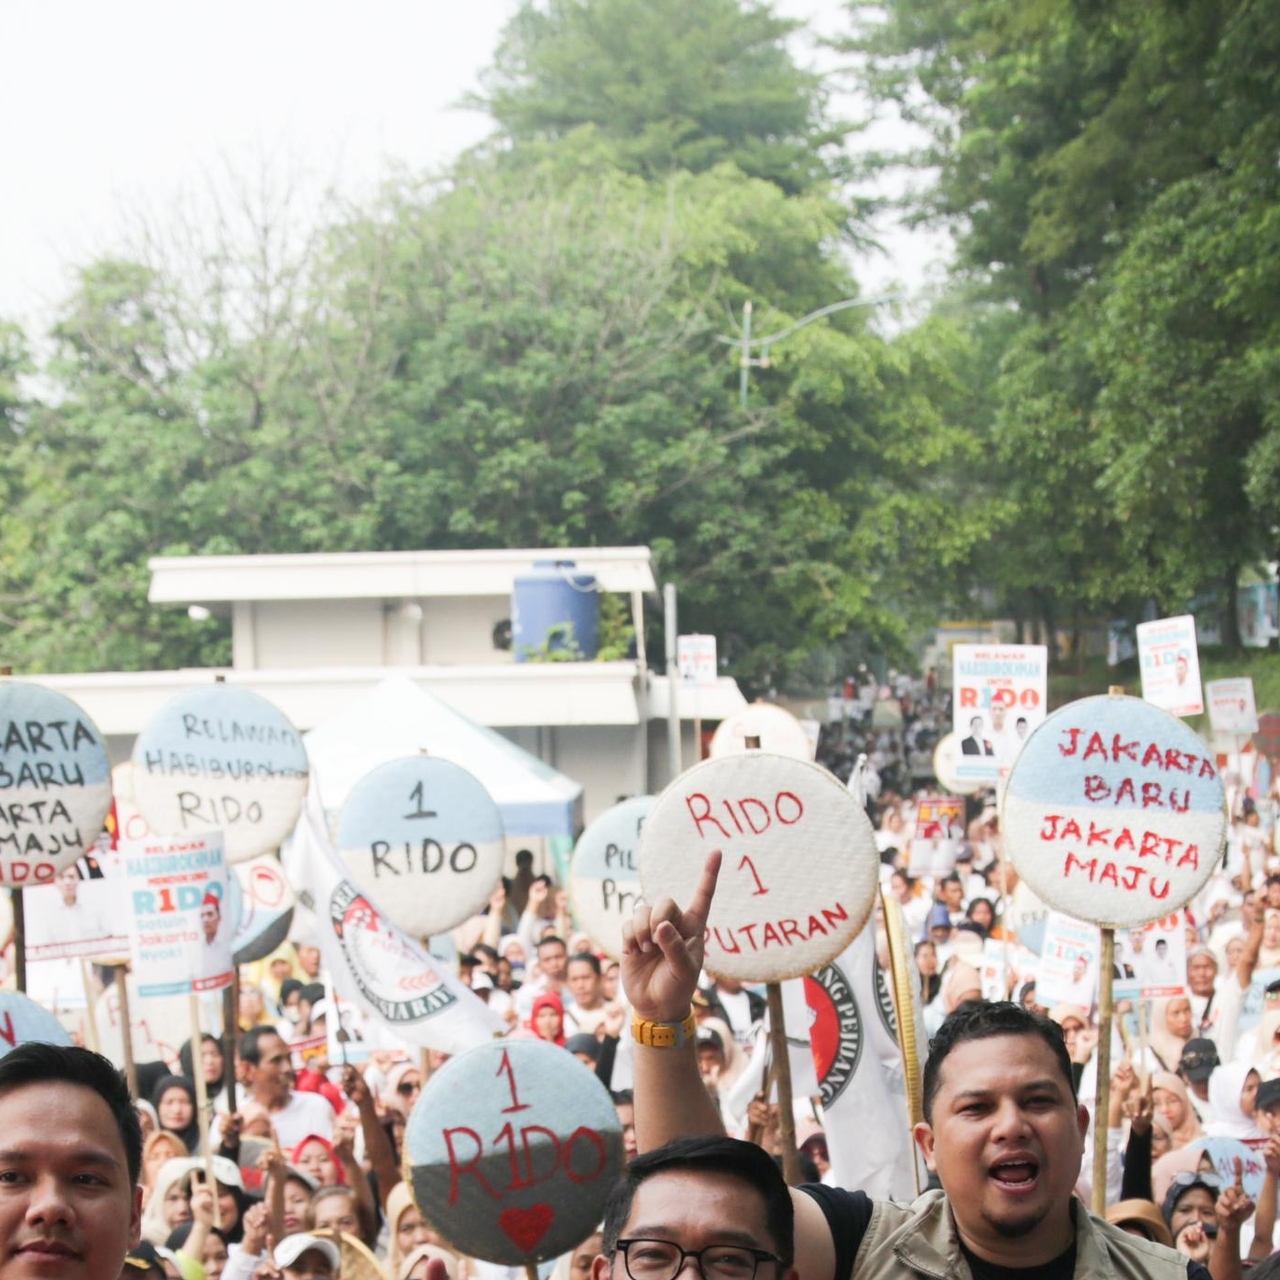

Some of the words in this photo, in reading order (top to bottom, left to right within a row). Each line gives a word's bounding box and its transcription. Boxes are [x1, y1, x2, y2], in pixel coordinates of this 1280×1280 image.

[1058, 727, 1217, 781] JAKARTA
[176, 790, 264, 829] RIDO
[404, 779, 437, 820] 1
[685, 791, 805, 840] RIDO
[1083, 775, 1191, 814] BARU
[370, 839, 478, 879] RIDO
[605, 843, 638, 871] PIL
[1039, 814, 1200, 871] JAKARTA
[737, 854, 770, 897] 1
[1063, 851, 1171, 900] MAJU
[494, 1047, 533, 1114] 1
